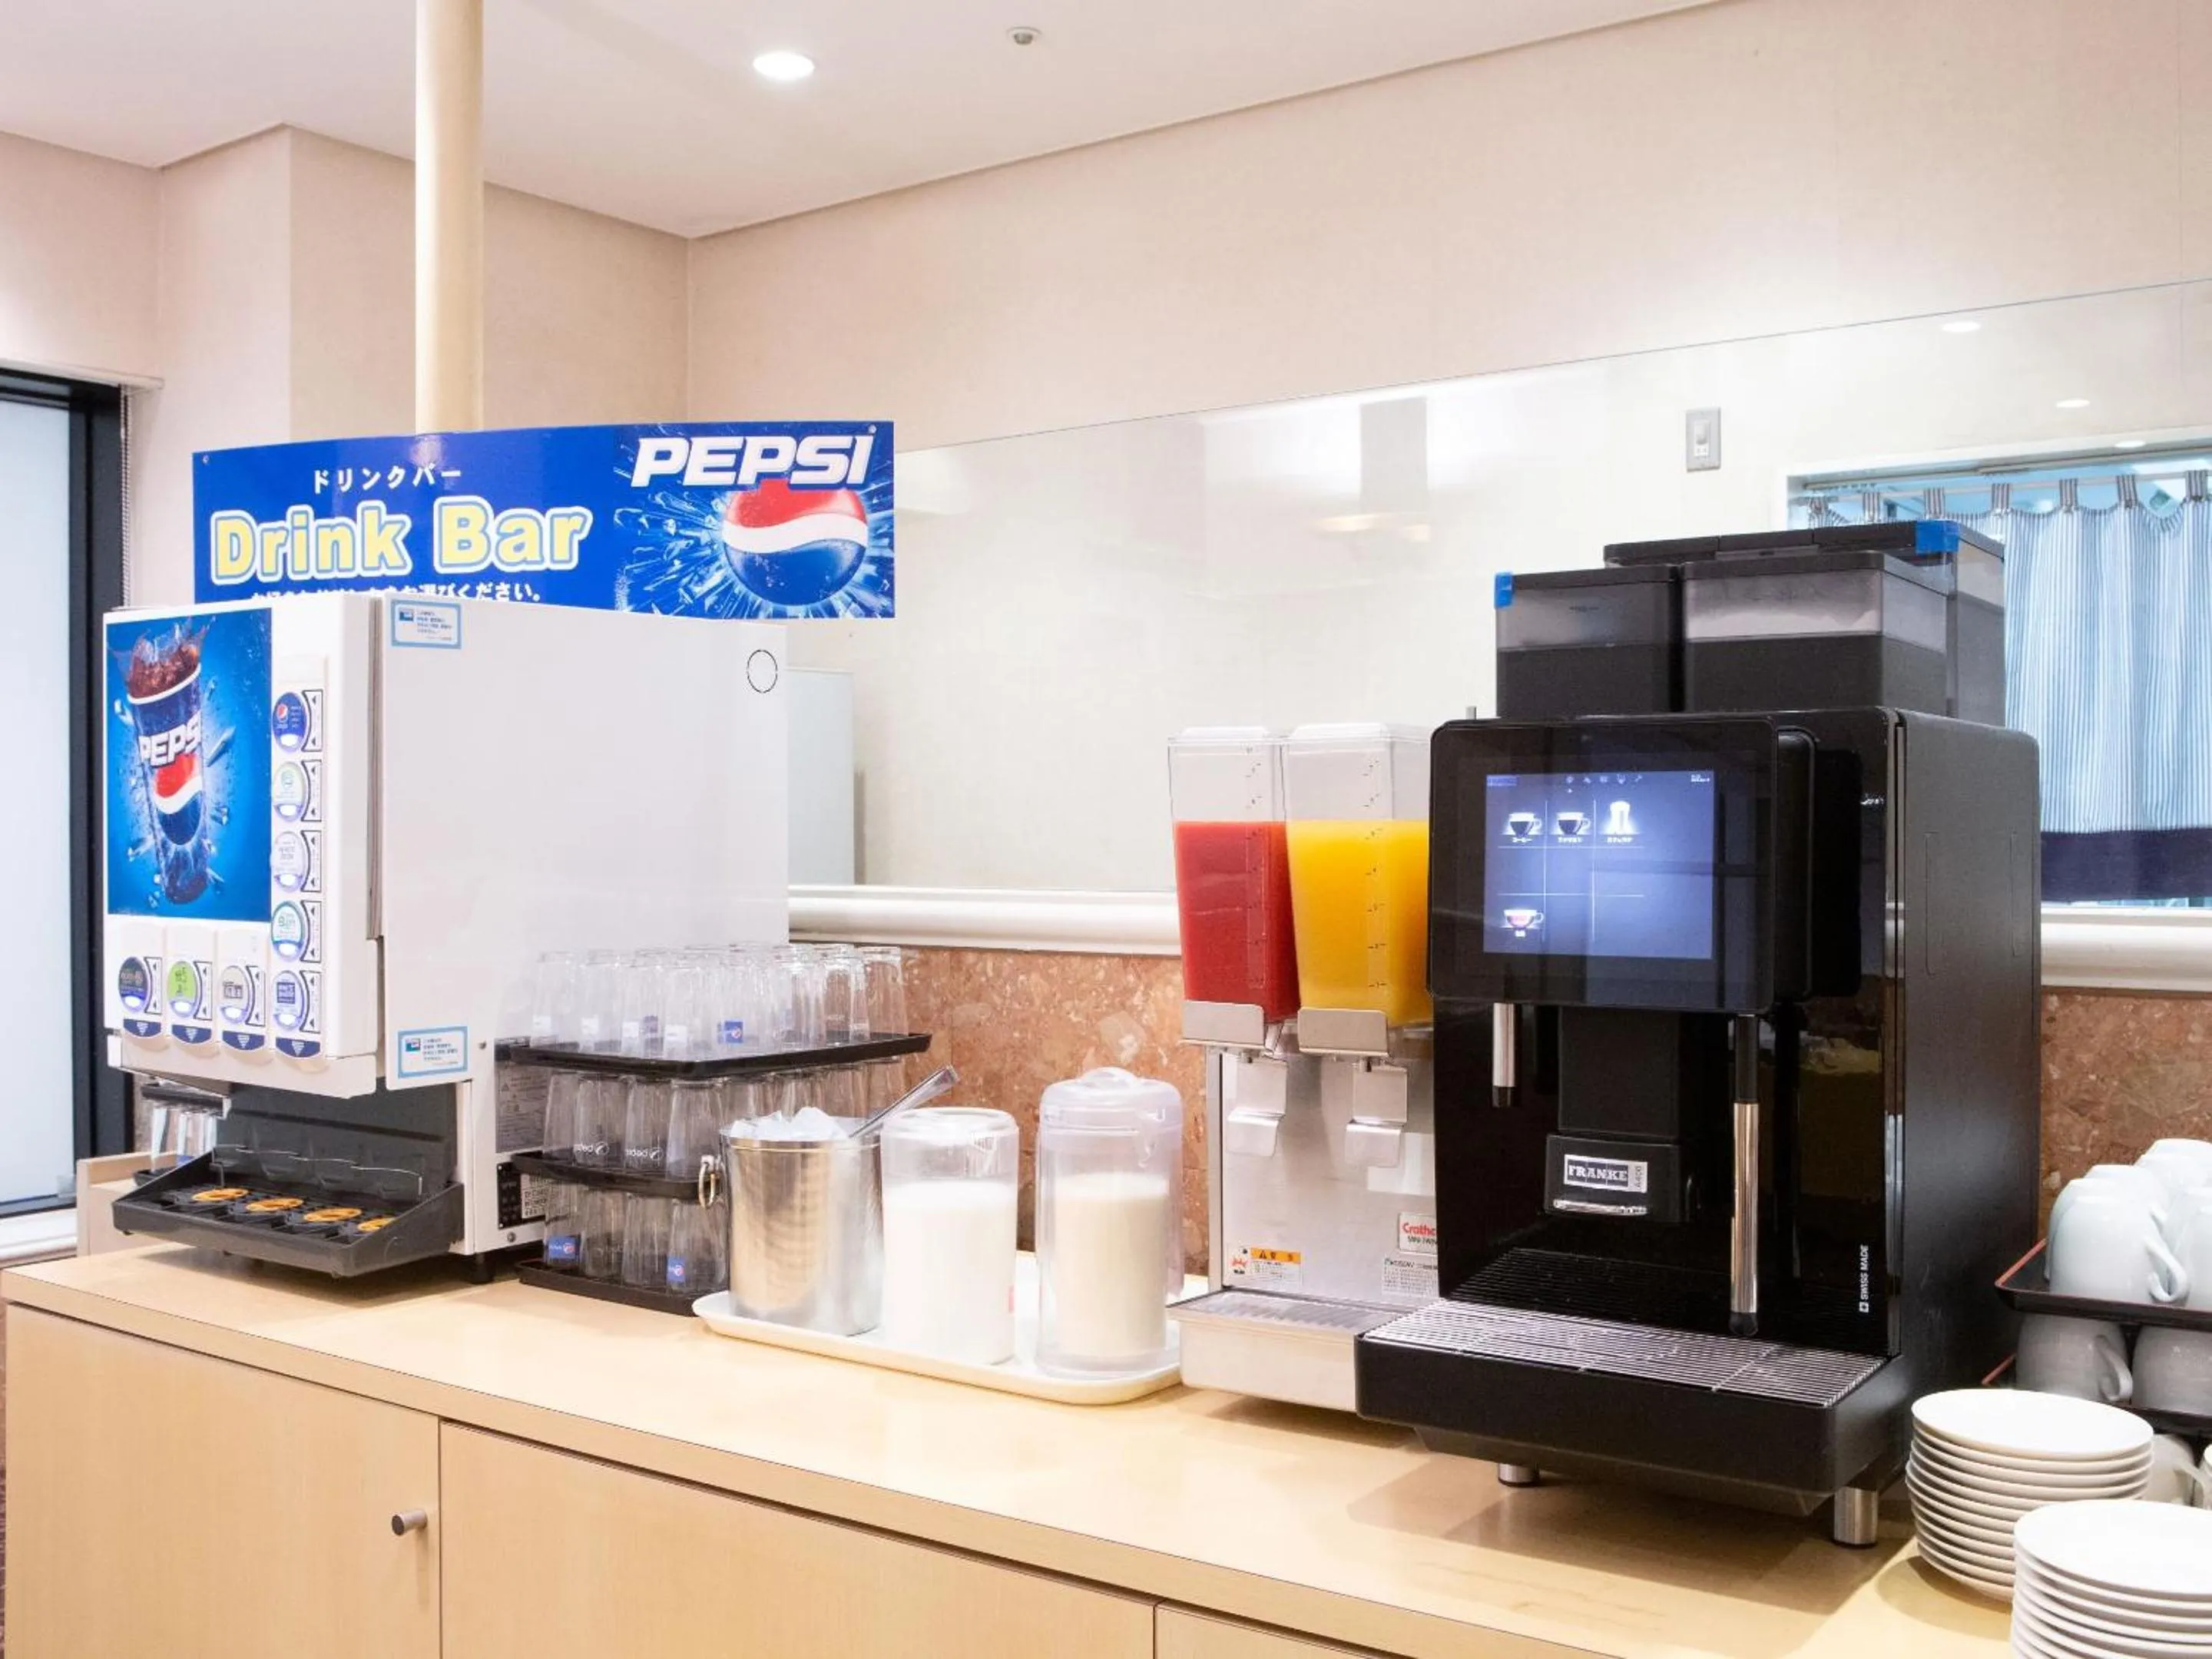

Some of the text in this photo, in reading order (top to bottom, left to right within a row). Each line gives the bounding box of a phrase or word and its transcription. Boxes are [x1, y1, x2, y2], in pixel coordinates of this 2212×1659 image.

[313, 462, 462, 494] ドリンクバー
[631, 435, 874, 487] PEPSI
[211, 495, 593, 585] Drink Bar
[1568, 1164, 1628, 1182] FRANKE
[1402, 1222, 1438, 1237] Crathc
[1859, 1244, 1869, 1300] SWISS MADE
